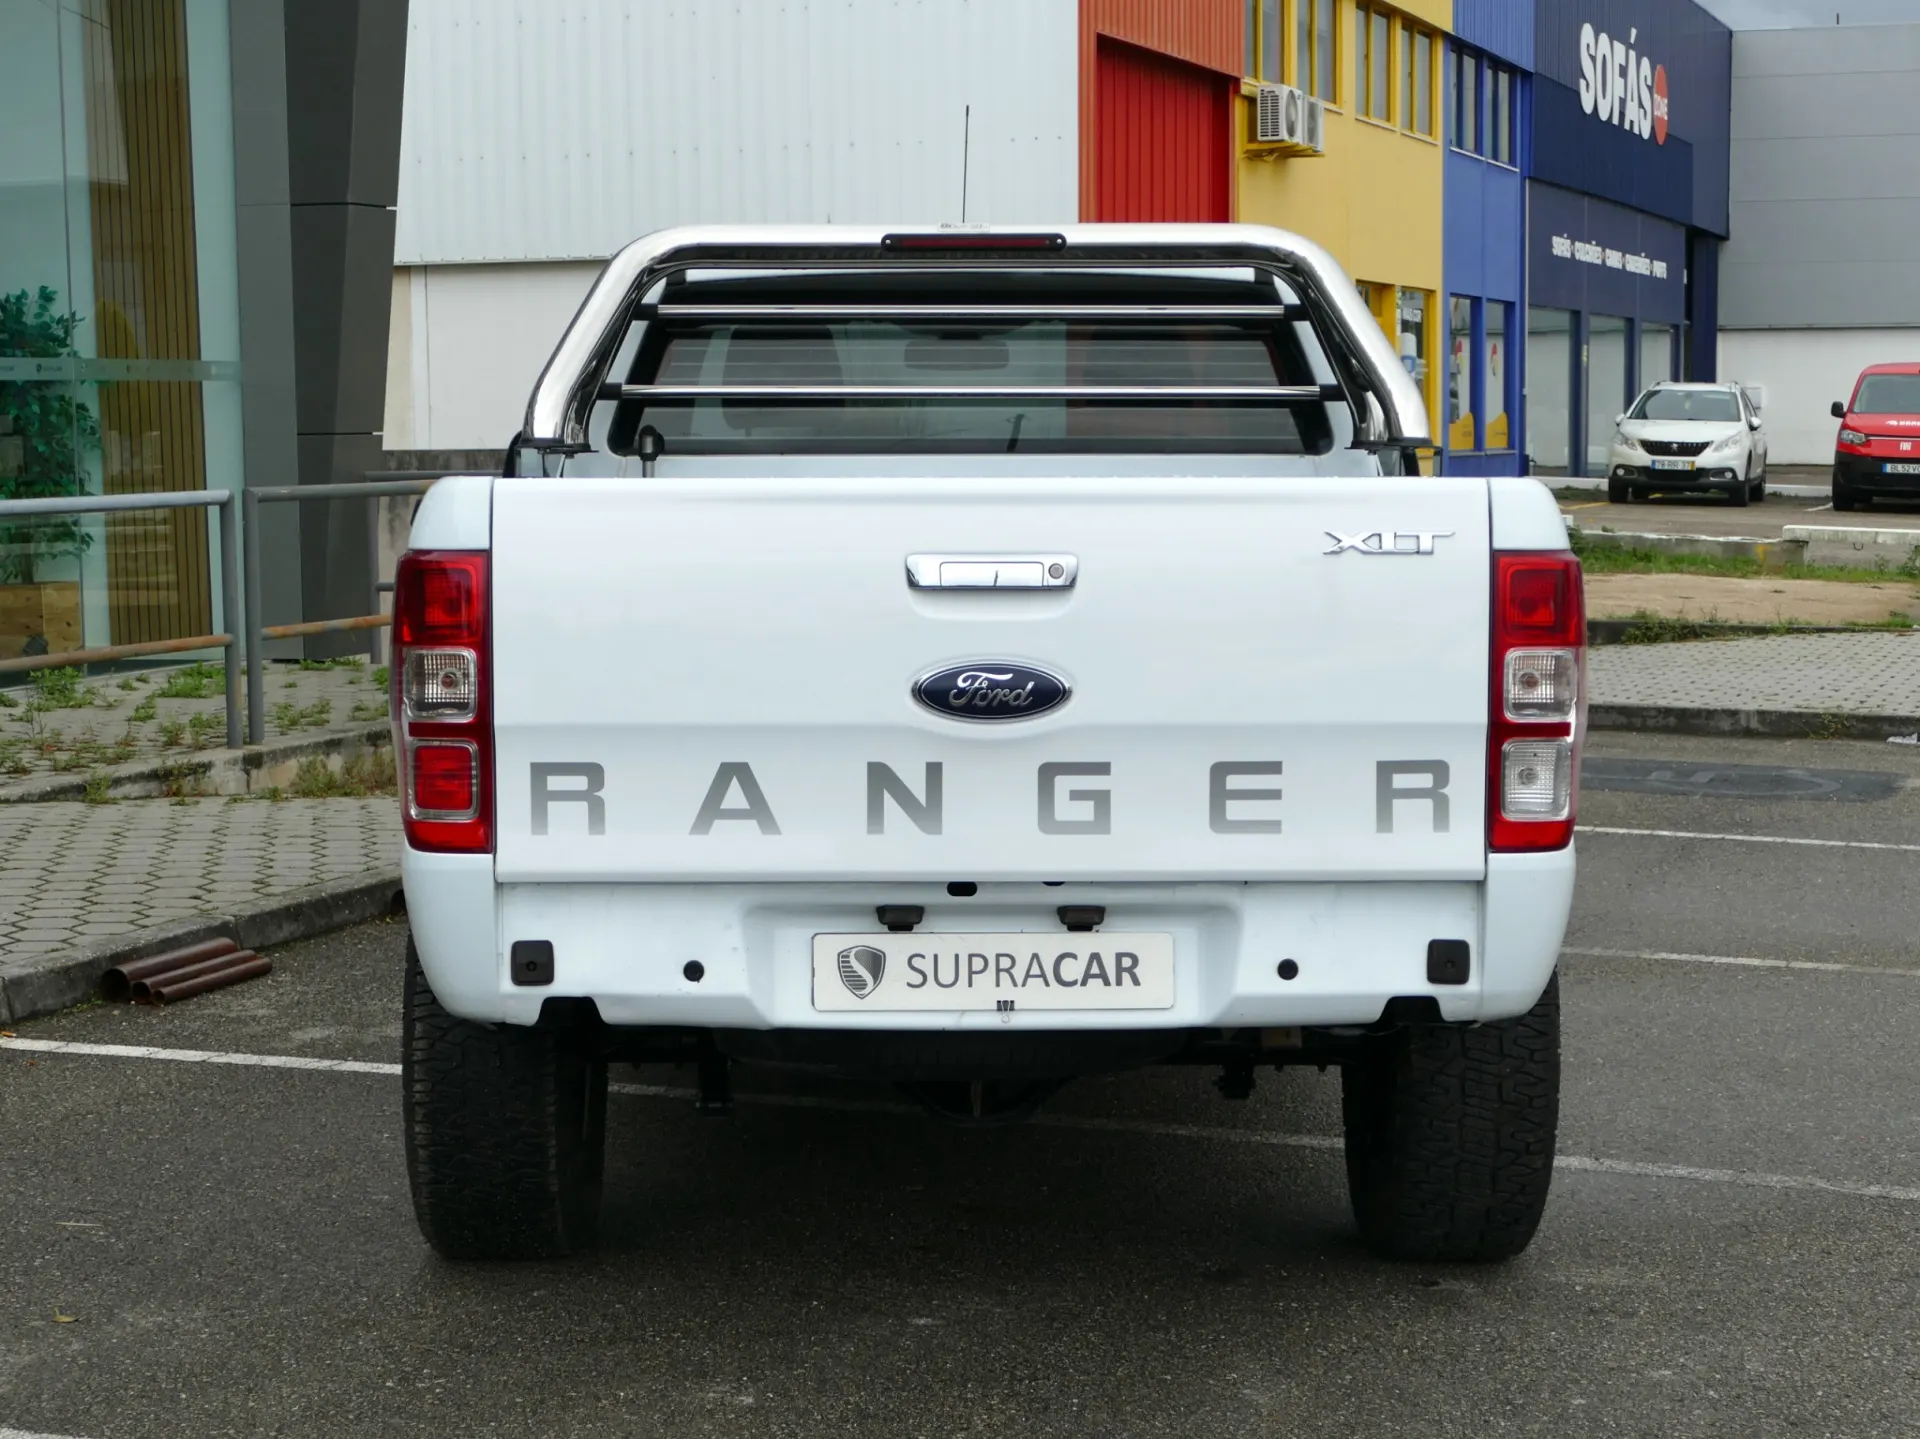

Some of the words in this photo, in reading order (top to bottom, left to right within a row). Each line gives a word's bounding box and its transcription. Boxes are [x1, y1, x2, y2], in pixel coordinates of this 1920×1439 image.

[1579, 22, 1652, 140] SOFÁS
[1323, 531, 1456, 555] XLT
[949, 671, 1035, 707] Ford
[529, 760, 1450, 835] RANGER
[906, 951, 1141, 988] SUPRACAR
